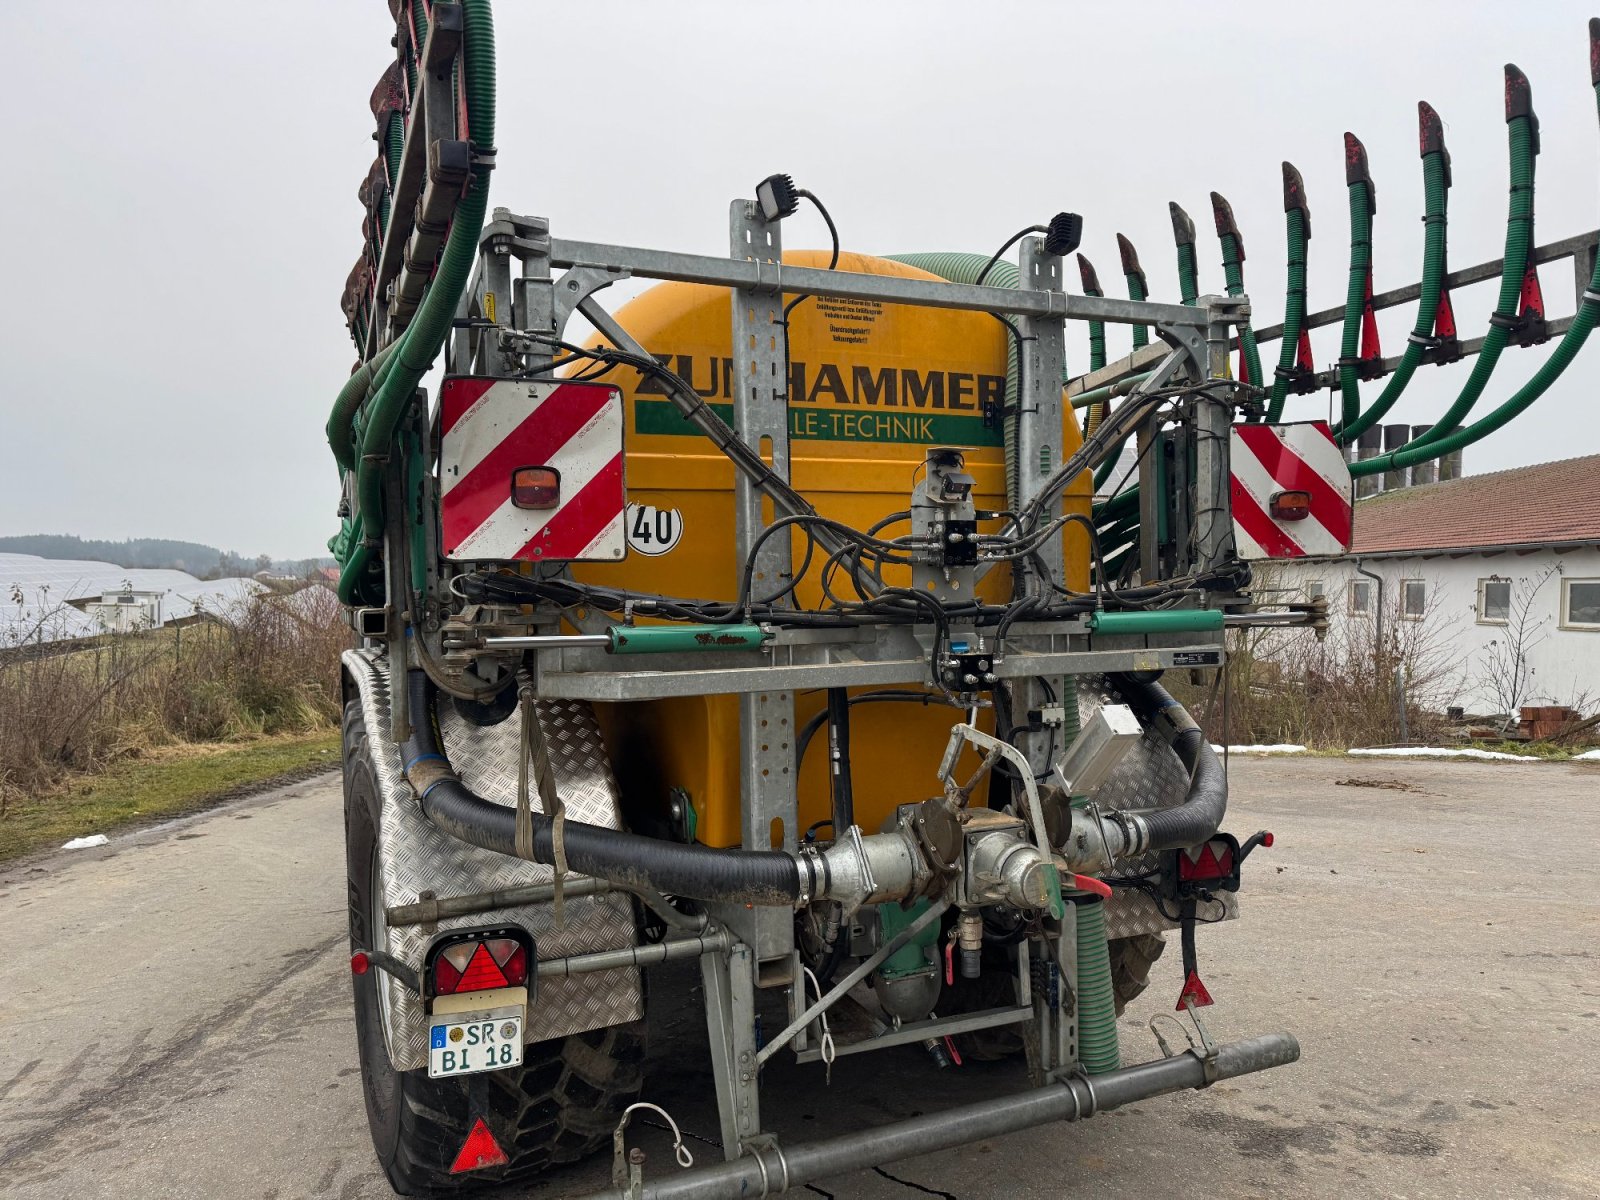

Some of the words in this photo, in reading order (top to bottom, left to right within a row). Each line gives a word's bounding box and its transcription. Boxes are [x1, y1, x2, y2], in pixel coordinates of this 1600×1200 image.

[789, 411, 934, 440] LE-TECHNIK
[632, 505, 672, 545] 40
[436, 1040, 443, 1048] D
[466, 1022, 495, 1046] SR
[442, 1048, 470, 1072] BI
[485, 1043, 512, 1065] 18
